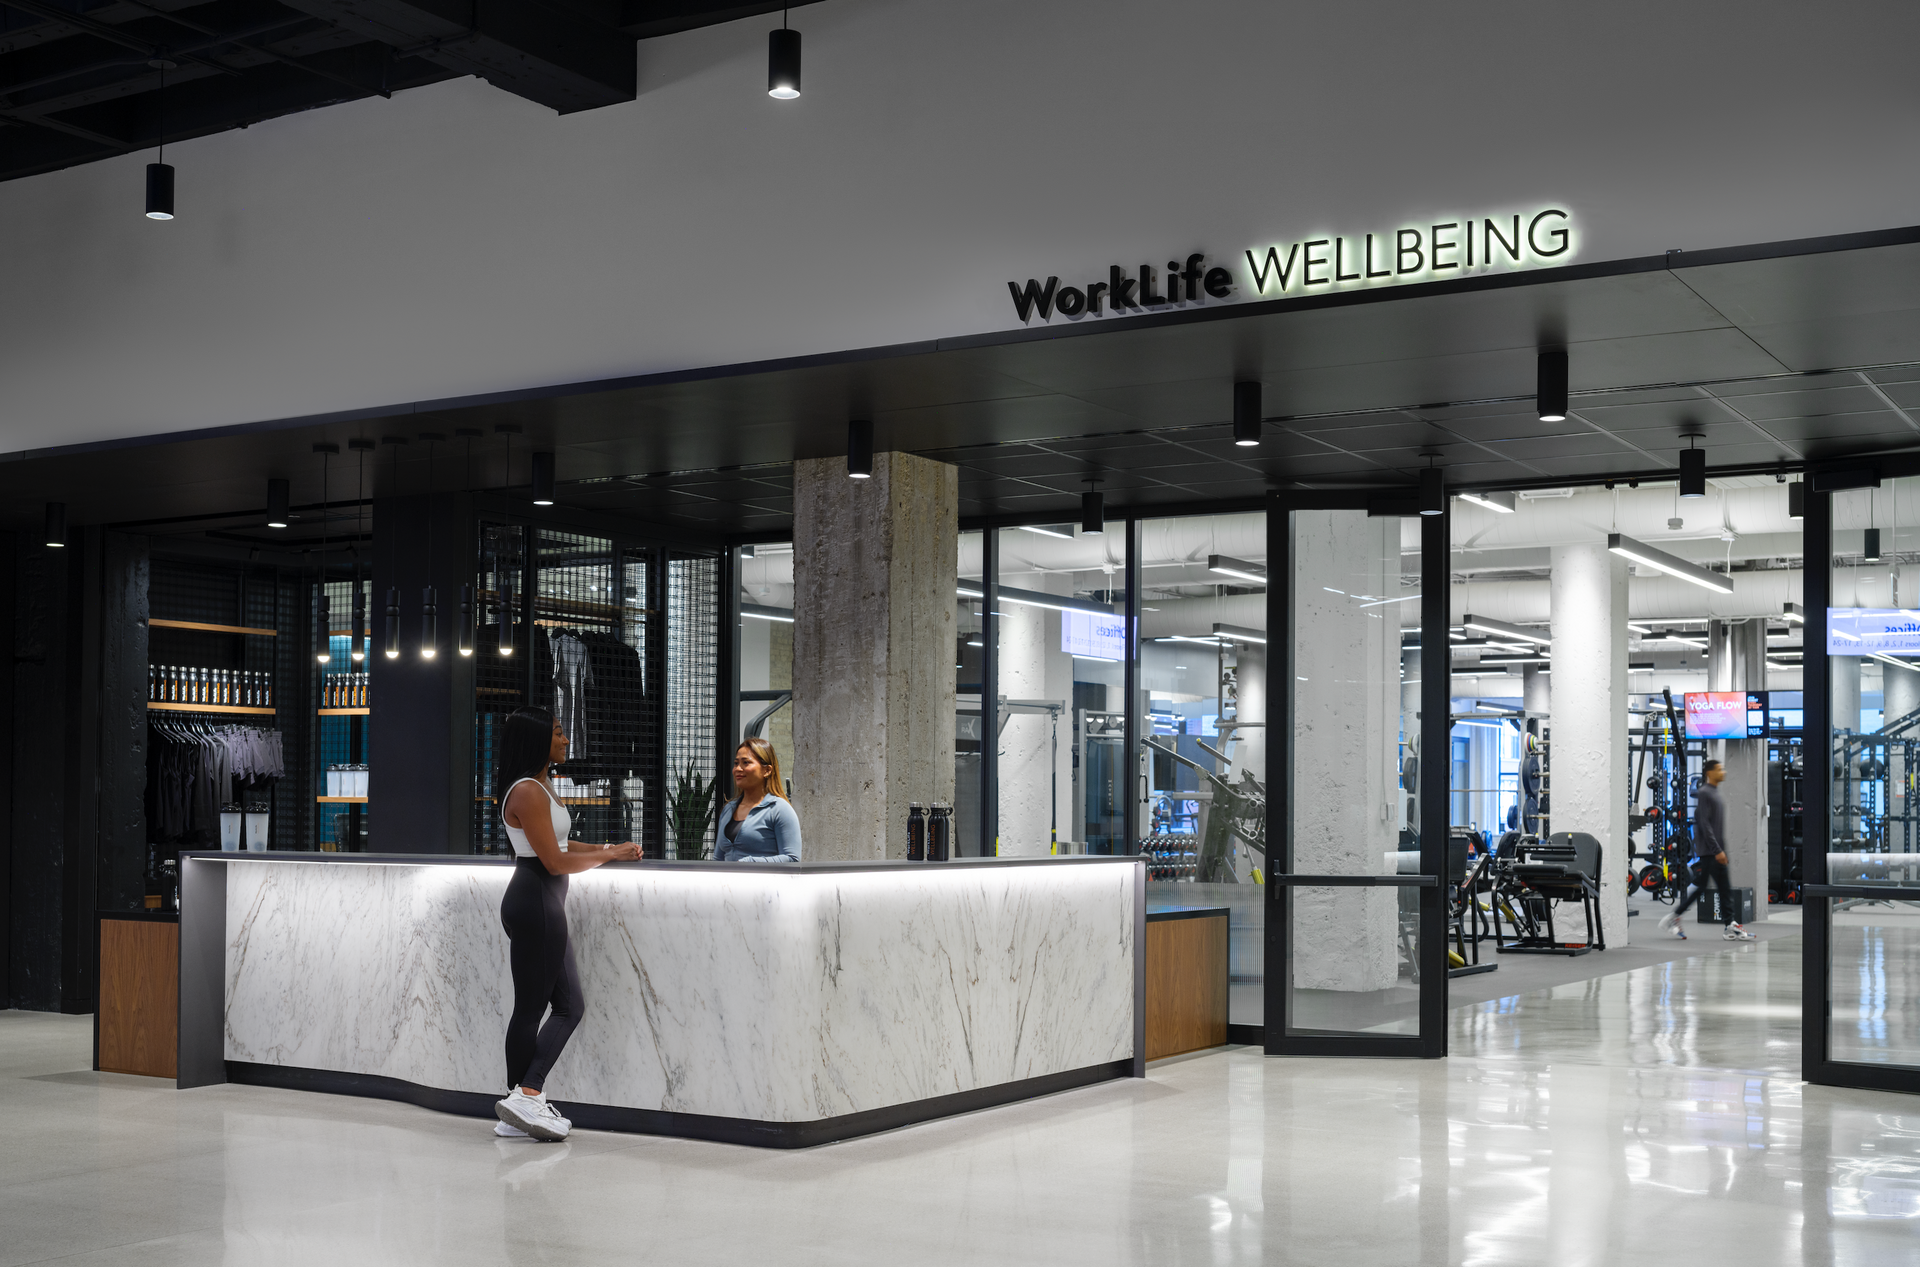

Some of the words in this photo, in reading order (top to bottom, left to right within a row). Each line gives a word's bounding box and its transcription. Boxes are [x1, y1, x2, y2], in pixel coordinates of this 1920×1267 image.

[1007, 254, 1233, 326] WorkLife
[1245, 209, 1570, 295] WELLBEING
[1689, 701, 1715, 711] YOGA
[1716, 701, 1742, 710] FLOW
[1714, 892, 1722, 920] POWER
